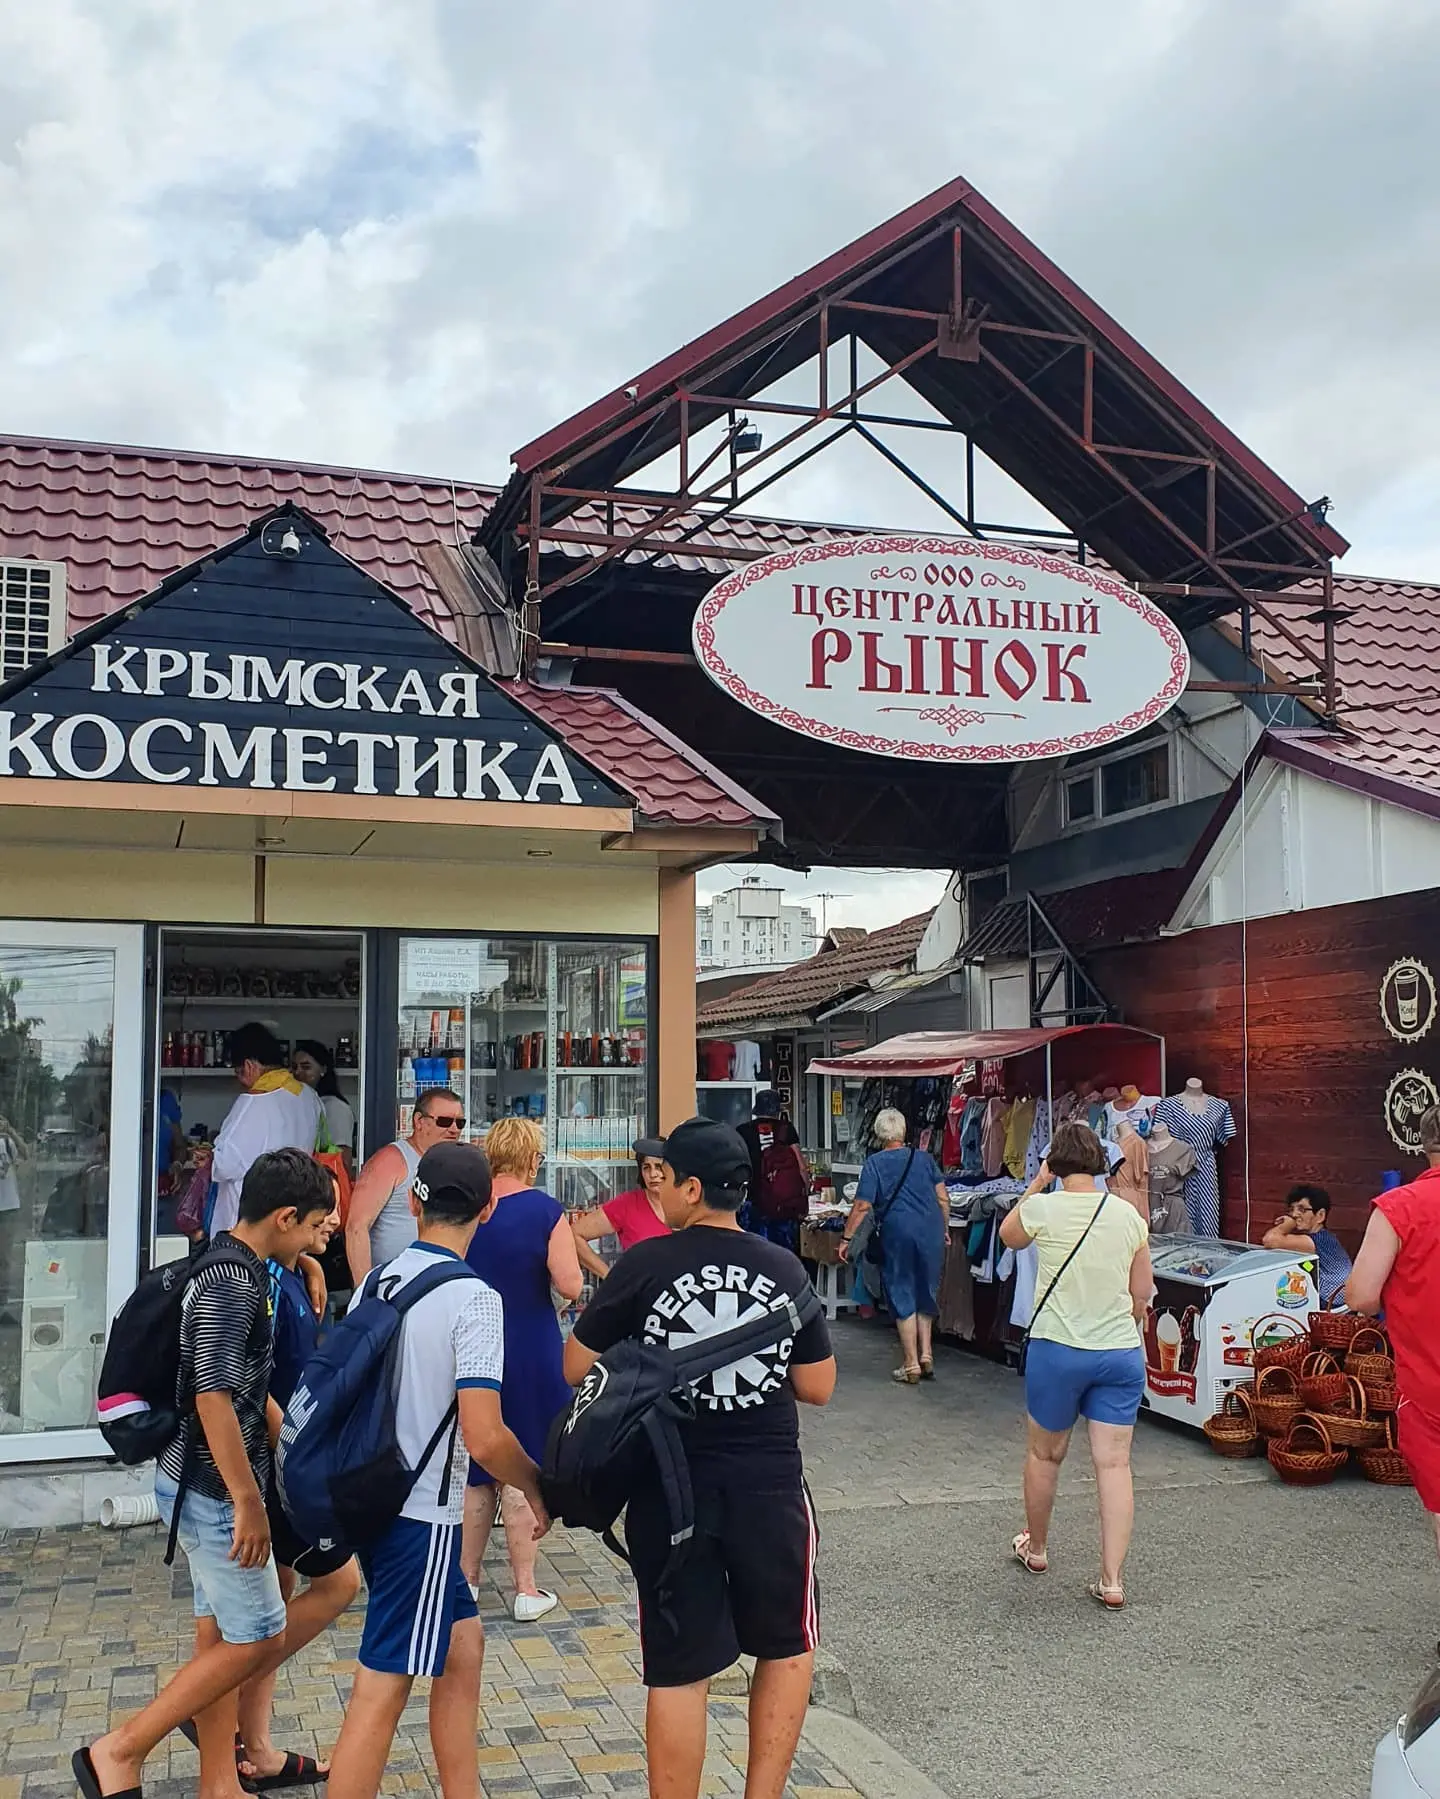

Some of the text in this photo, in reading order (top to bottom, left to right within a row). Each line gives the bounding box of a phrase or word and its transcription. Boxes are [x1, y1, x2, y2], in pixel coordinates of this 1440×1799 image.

[791, 583, 1102, 634] ЦЕНТРАЛЬНЫЙ
[923, 562, 974, 588] ООО
[90, 643, 481, 719] КРЫМСКАЯ
[805, 627, 1092, 704] РЫНОК
[0, 709, 583, 805] КОСМЕТИКА
